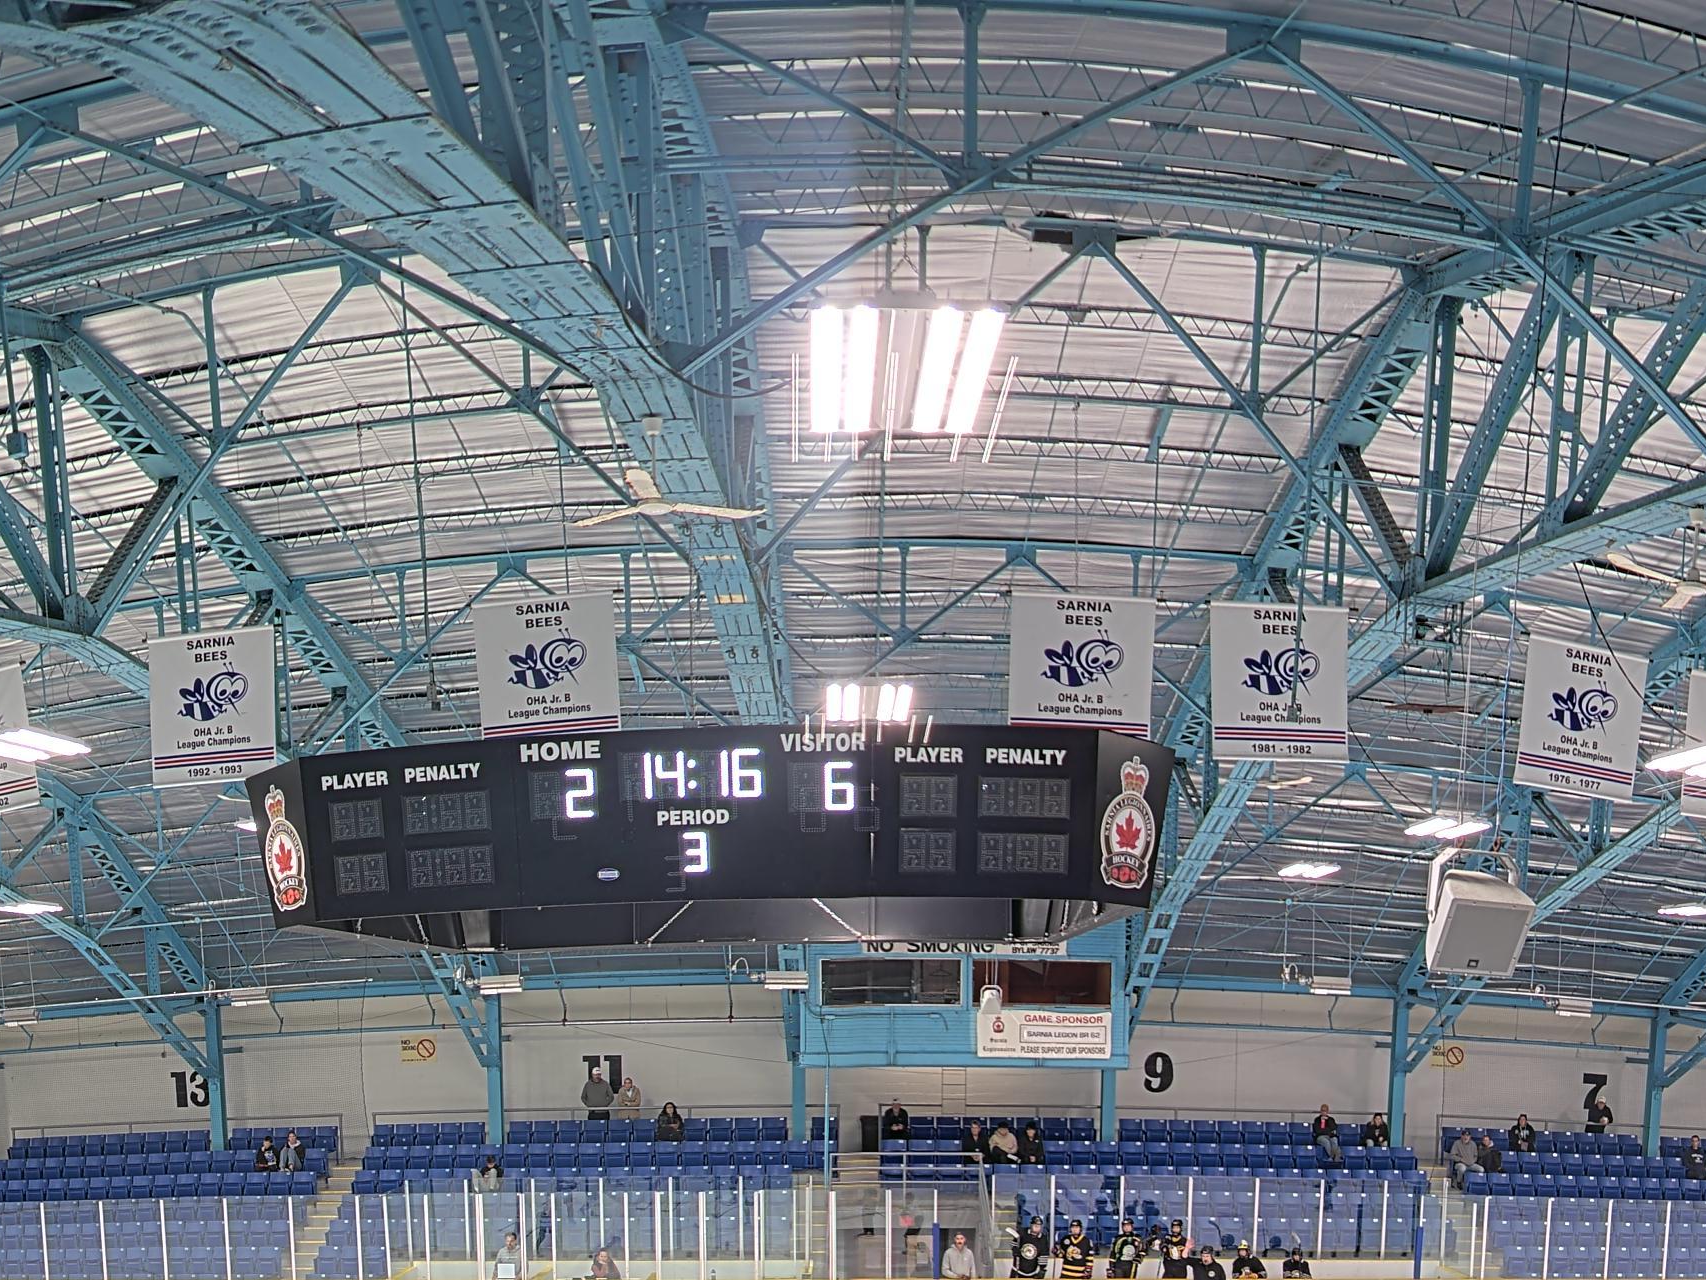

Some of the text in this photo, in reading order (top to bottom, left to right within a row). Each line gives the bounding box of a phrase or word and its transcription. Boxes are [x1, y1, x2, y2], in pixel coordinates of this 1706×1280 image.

[516, 601, 570, 616] SARNIA
[1056, 600, 1112, 613] SARNIA
[525, 616, 563, 629] BEES
[1065, 615, 1103, 626] BEES
[1262, 624, 1298, 636] BEES
[187, 636, 235, 650] SARNIA
[195, 651, 227, 663] BEES
[1566, 648, 1612, 667] SARNIA
[1572, 663, 1603, 678] BEES
[526, 694, 571, 706] OHA Jr. B
[1058, 693, 1103, 704] OHA Jr. B
[508, 704, 591, 720] League Champions
[1038, 703, 1123, 717] League Champions
[1259, 702, 1279, 712] OHA
[1240, 712, 1272, 724] League
[194, 728, 211, 737] OHA
[177, 735, 251, 750] League Champions
[780, 732, 866, 752] VISITOR
[1560, 735, 1578, 746] OHA
[519, 740, 601, 763] HOME
[1252, 744, 1312, 754] 1981 1982
[1543, 742, 1613, 764] League Champions
[894, 747, 1067, 766] PLAYER PENALTY
[188, 765, 242, 777] 1992 1993
[321, 762, 481, 791] PLAYER PENALTY
[643, 747, 763, 800] 14:16
[823, 761, 855, 811] 6
[1549, 773, 1601, 790] 1976 1977
[564, 767, 595, 819] 2
[656, 809, 730, 827] PERIOD
[682, 831, 709, 873] 3
[1112, 854, 1139, 868] HOCKEY
[867, 942, 993, 953] NO SMOKING
[1024, 1014, 1104, 1024] GAME SPONSOR
[1054, 1031, 1078, 1039] LEGION
[1020, 1045, 1106, 1055] PLEASE SUPPORT OUR SPONSORS
[583, 1055, 625, 1095] 11
[1143, 1052, 1174, 1093] 9
[169, 1070, 211, 1109] 13
[1582, 1073, 1608, 1110] 7
